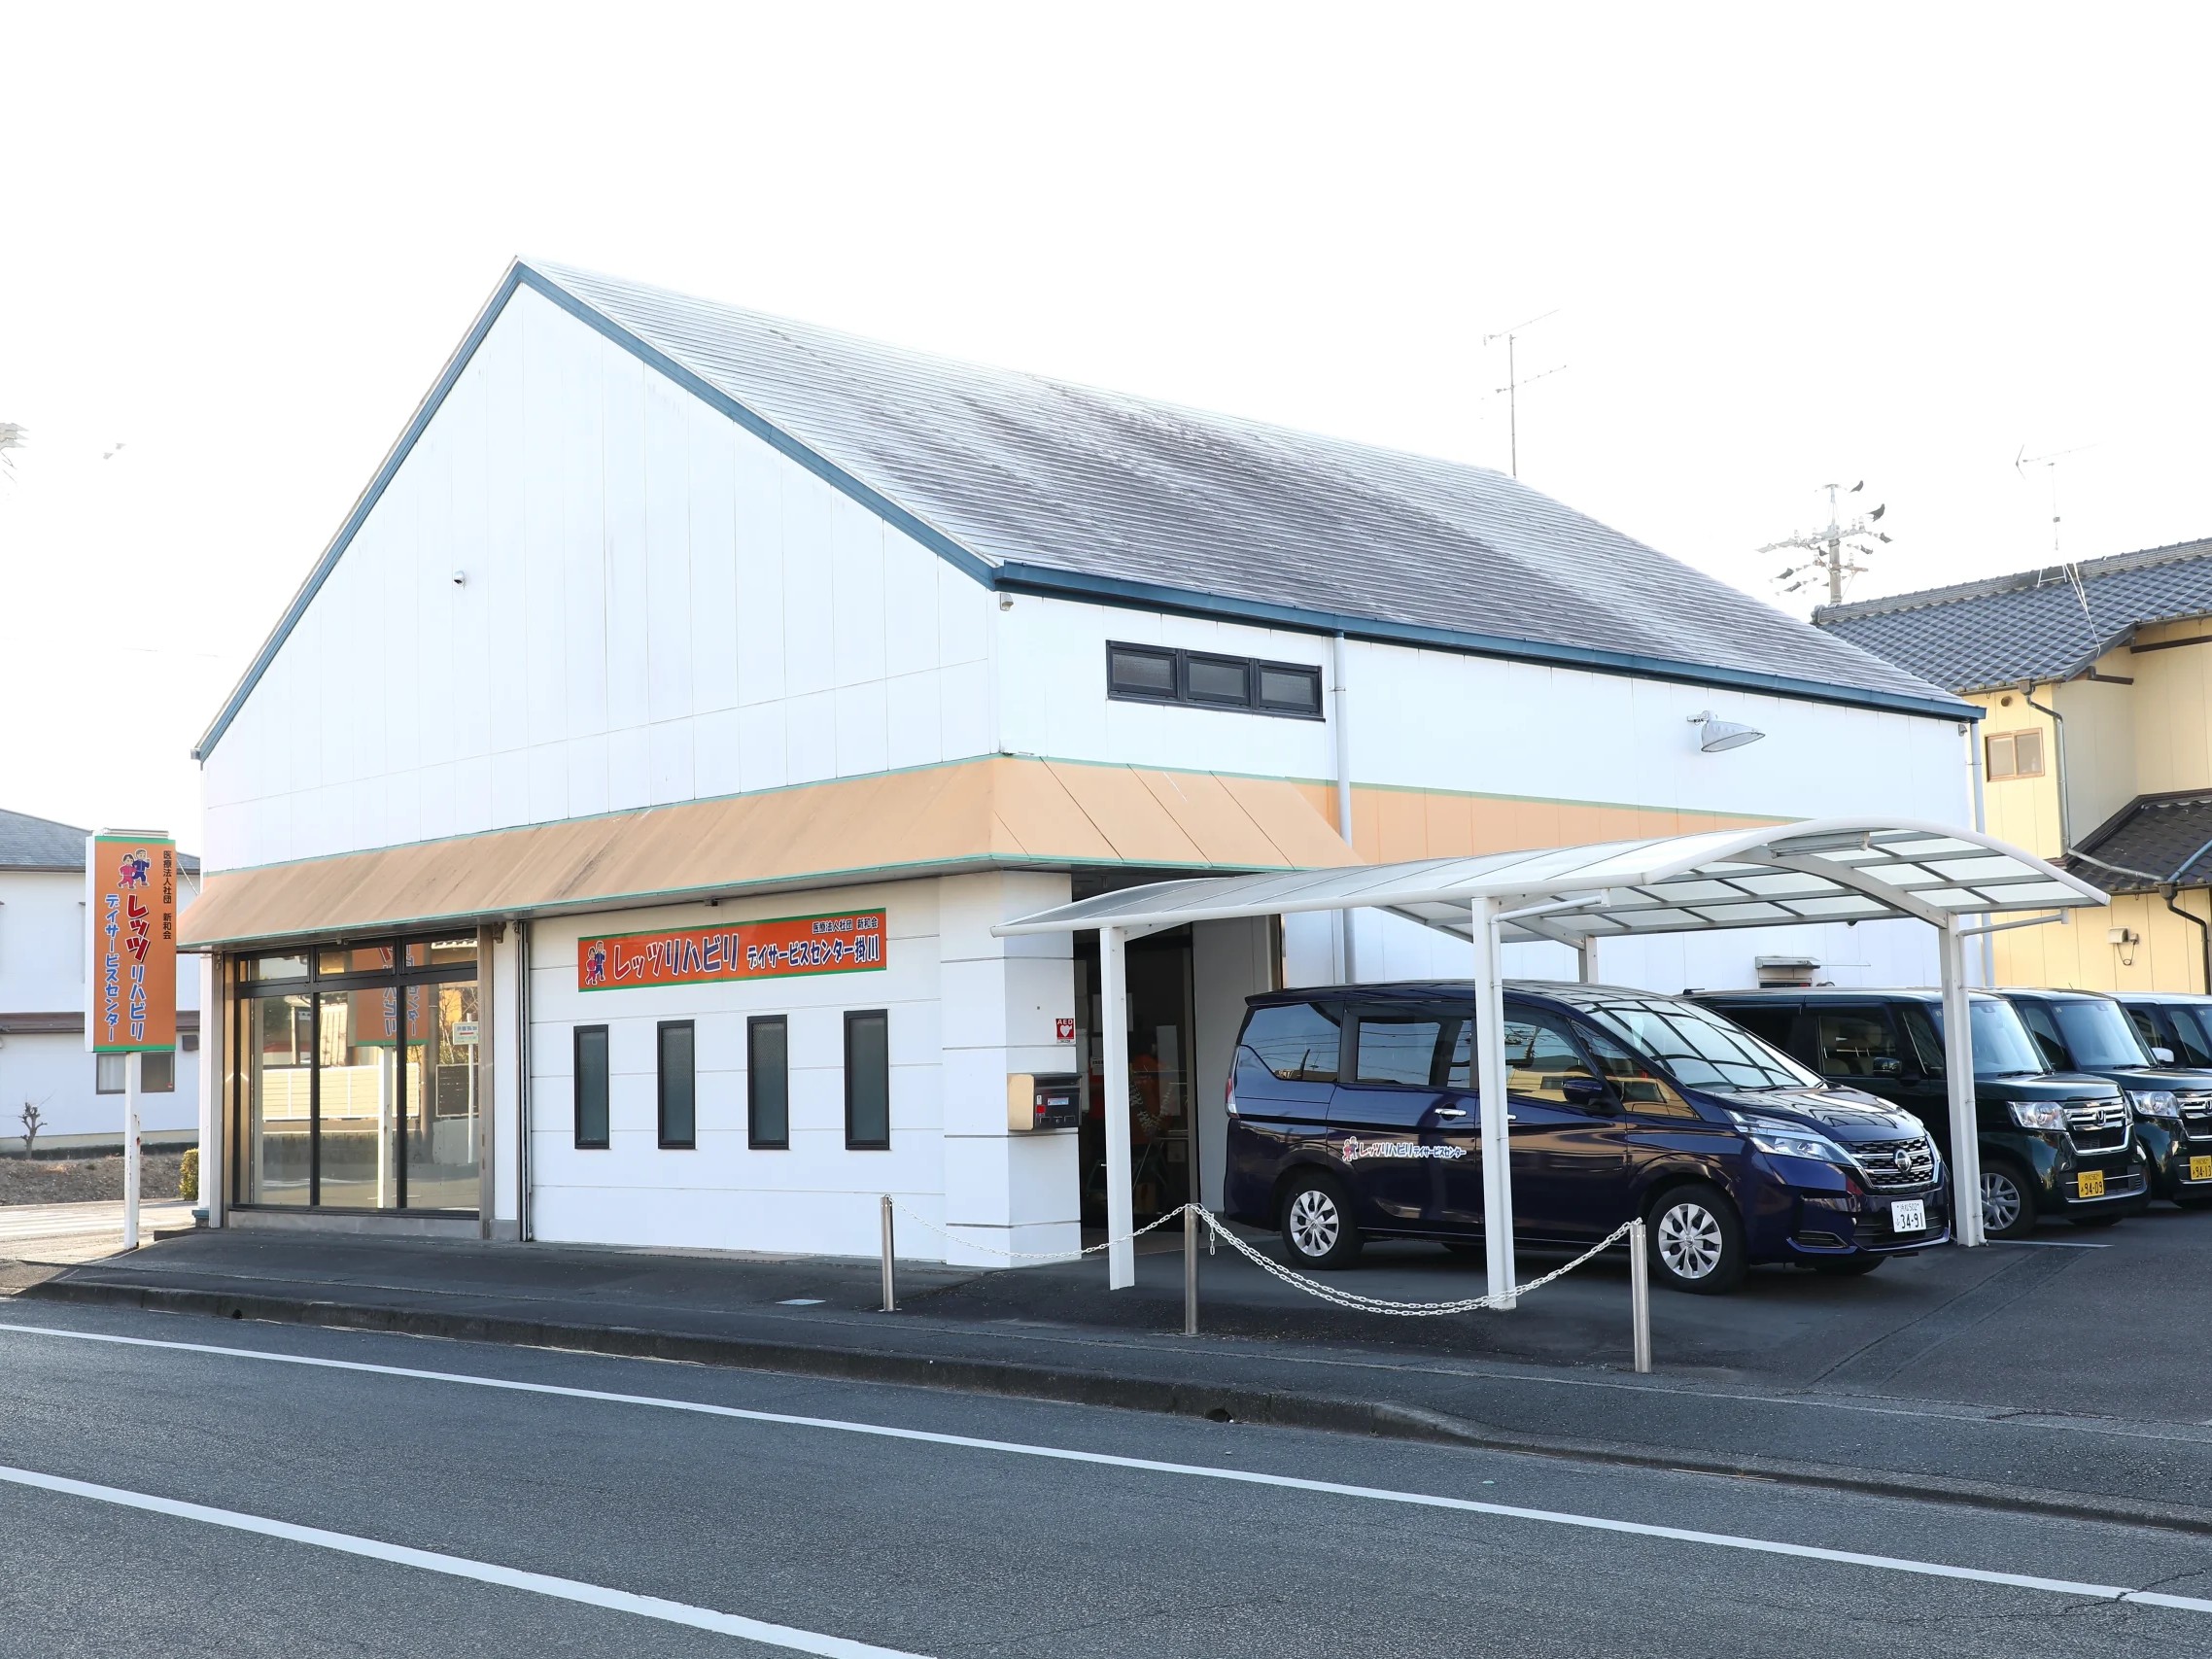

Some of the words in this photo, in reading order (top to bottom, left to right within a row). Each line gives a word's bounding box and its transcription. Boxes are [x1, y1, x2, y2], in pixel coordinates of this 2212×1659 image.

[162, 850, 172, 904] 医療法人社団
[162, 913, 172, 940] 新和会
[812, 919, 852, 934] 医療法人社団
[857, 916, 879, 930] 新和会
[105, 894, 120, 1042] デイサービスセンター
[125, 894, 150, 1042] レッツリハビリ
[613, 933, 739, 980] レッツリハビリ
[746, 934, 880, 970] デイサービスセンター掛川
[1360, 1142, 1414, 1158] レッツリハビリ
[1413, 1146, 1468, 1158] デイサービスセンター
